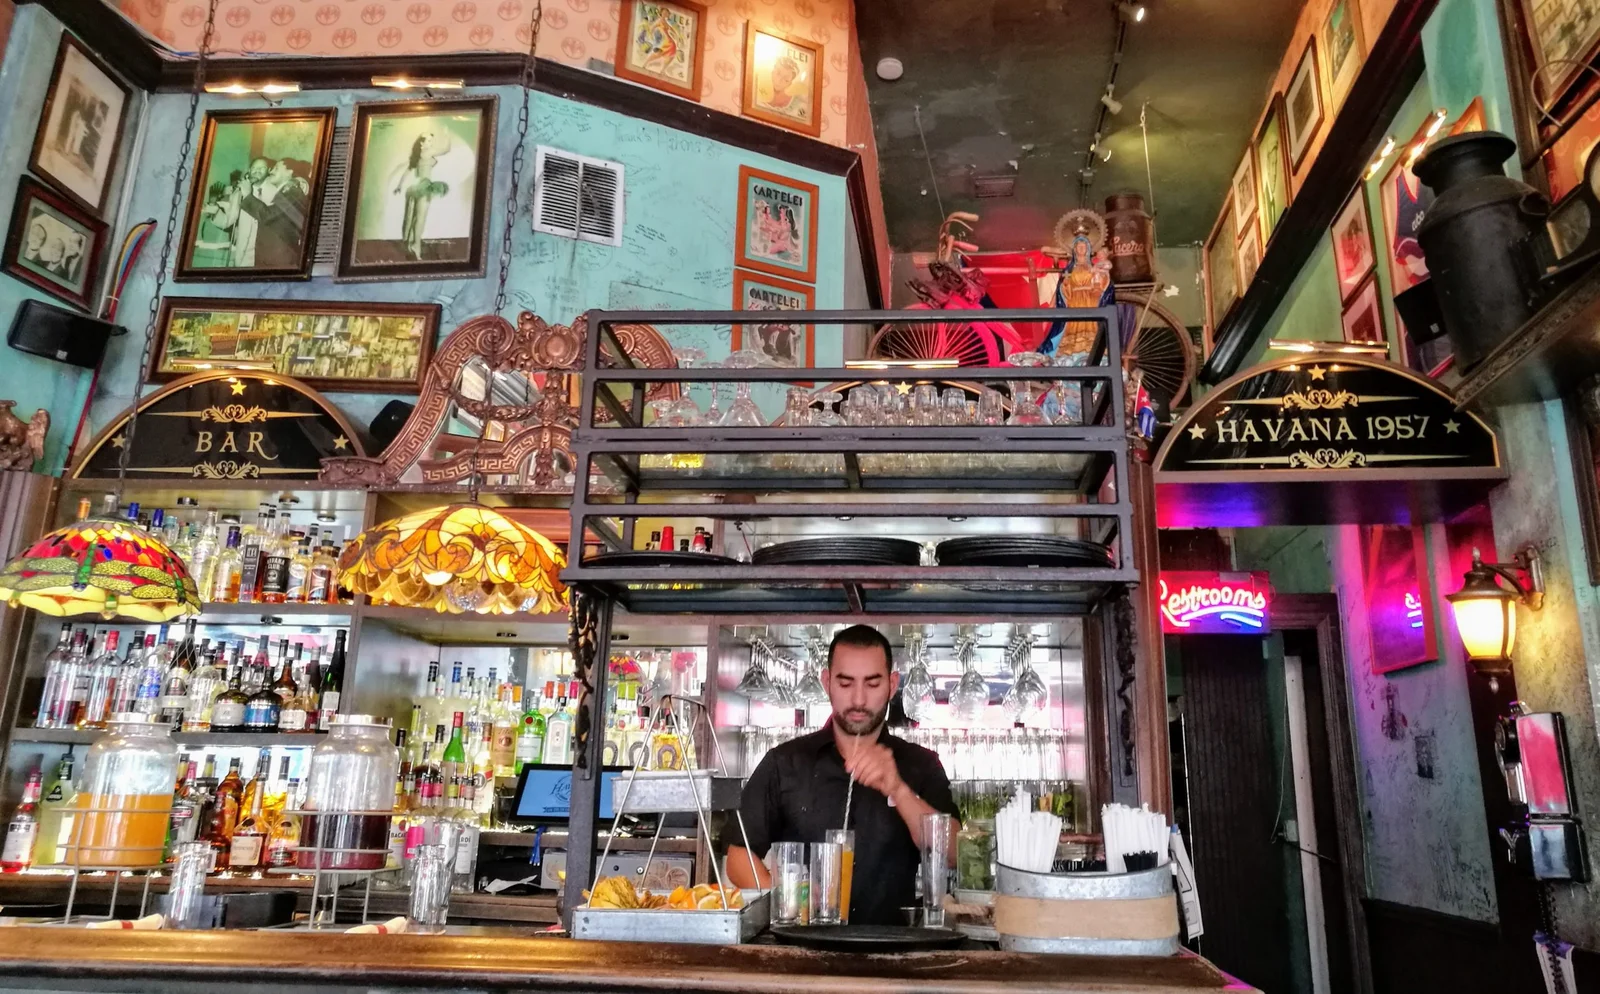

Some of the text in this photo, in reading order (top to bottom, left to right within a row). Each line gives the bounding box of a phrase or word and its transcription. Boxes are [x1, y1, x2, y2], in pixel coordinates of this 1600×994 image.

[1216, 414, 1431, 444] HAVANA 1957
[195, 430, 279, 460] BAR
